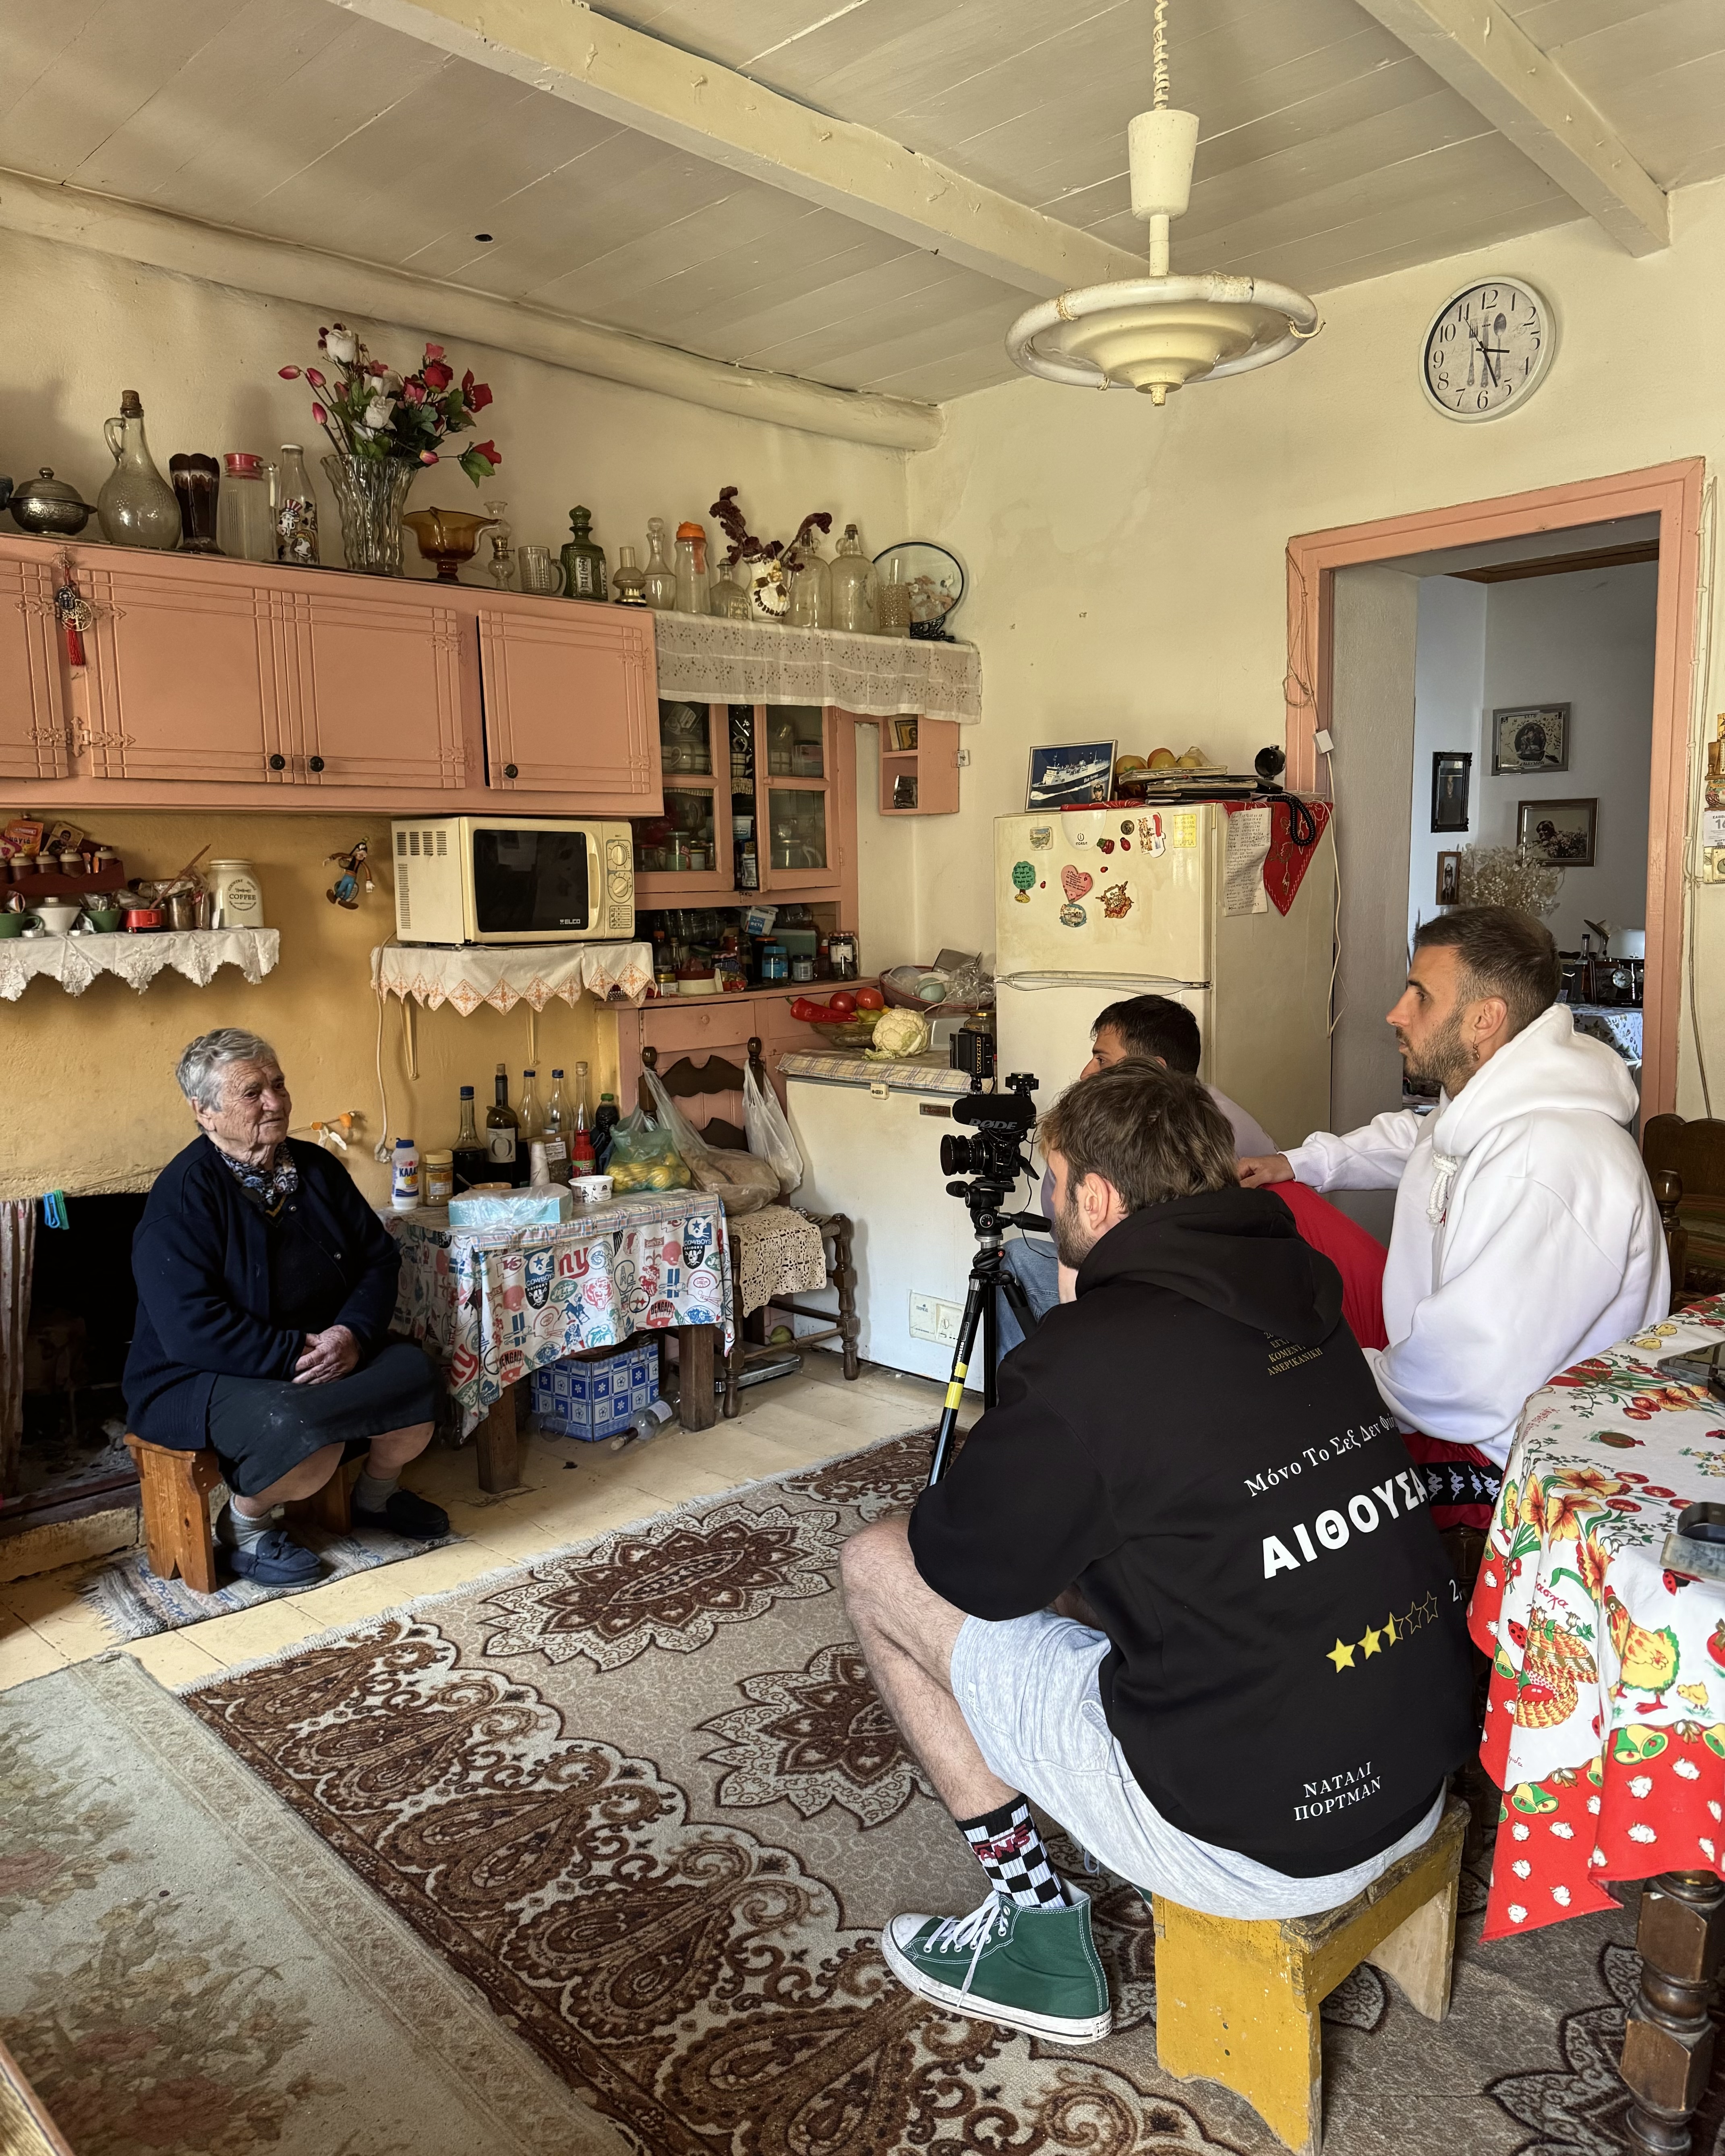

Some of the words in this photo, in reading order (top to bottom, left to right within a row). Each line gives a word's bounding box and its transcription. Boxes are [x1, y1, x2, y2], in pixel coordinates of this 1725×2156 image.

[1482, 290, 1498, 310] 12
[1511, 292, 1516, 311] 1
[1458, 302, 1470, 322] 11
[1523, 306, 1536, 326] 2
[1440, 324, 1456, 343] 10
[1433, 350, 1444, 368] 9
[1519, 357, 1532, 375] 4
[1437, 372, 1448, 390] 8
[1502, 379, 1512, 397] 5
[1455, 389, 1466, 407] 7
[1477, 390, 1488, 409] 6
[969, 1118, 1017, 1130] RØDE
[526, 1272, 555, 1287] COWBOYS
[527, 1283, 548, 1292] RAIDERS
[651, 1302, 673, 1315] BENGALS
[1267, 1347, 1323, 1376] ΑΜΕΡΙΚΑΝΙΚΗ
[1244, 1462, 1302, 1497] Μόνο
[1303, 1448, 1329, 1466] Το
[1329, 1430, 1361, 1455] Σεξ
[1360, 1422, 1381, 1442] Δεν
[1263, 1468, 1428, 1579] ΑΙΘΟΥΣΑ
[1303, 1761, 1372, 1798] ΝΑΤΑΛΙ
[1294, 1776, 1382, 1821] ΠΟΡΤΜΑΝ
